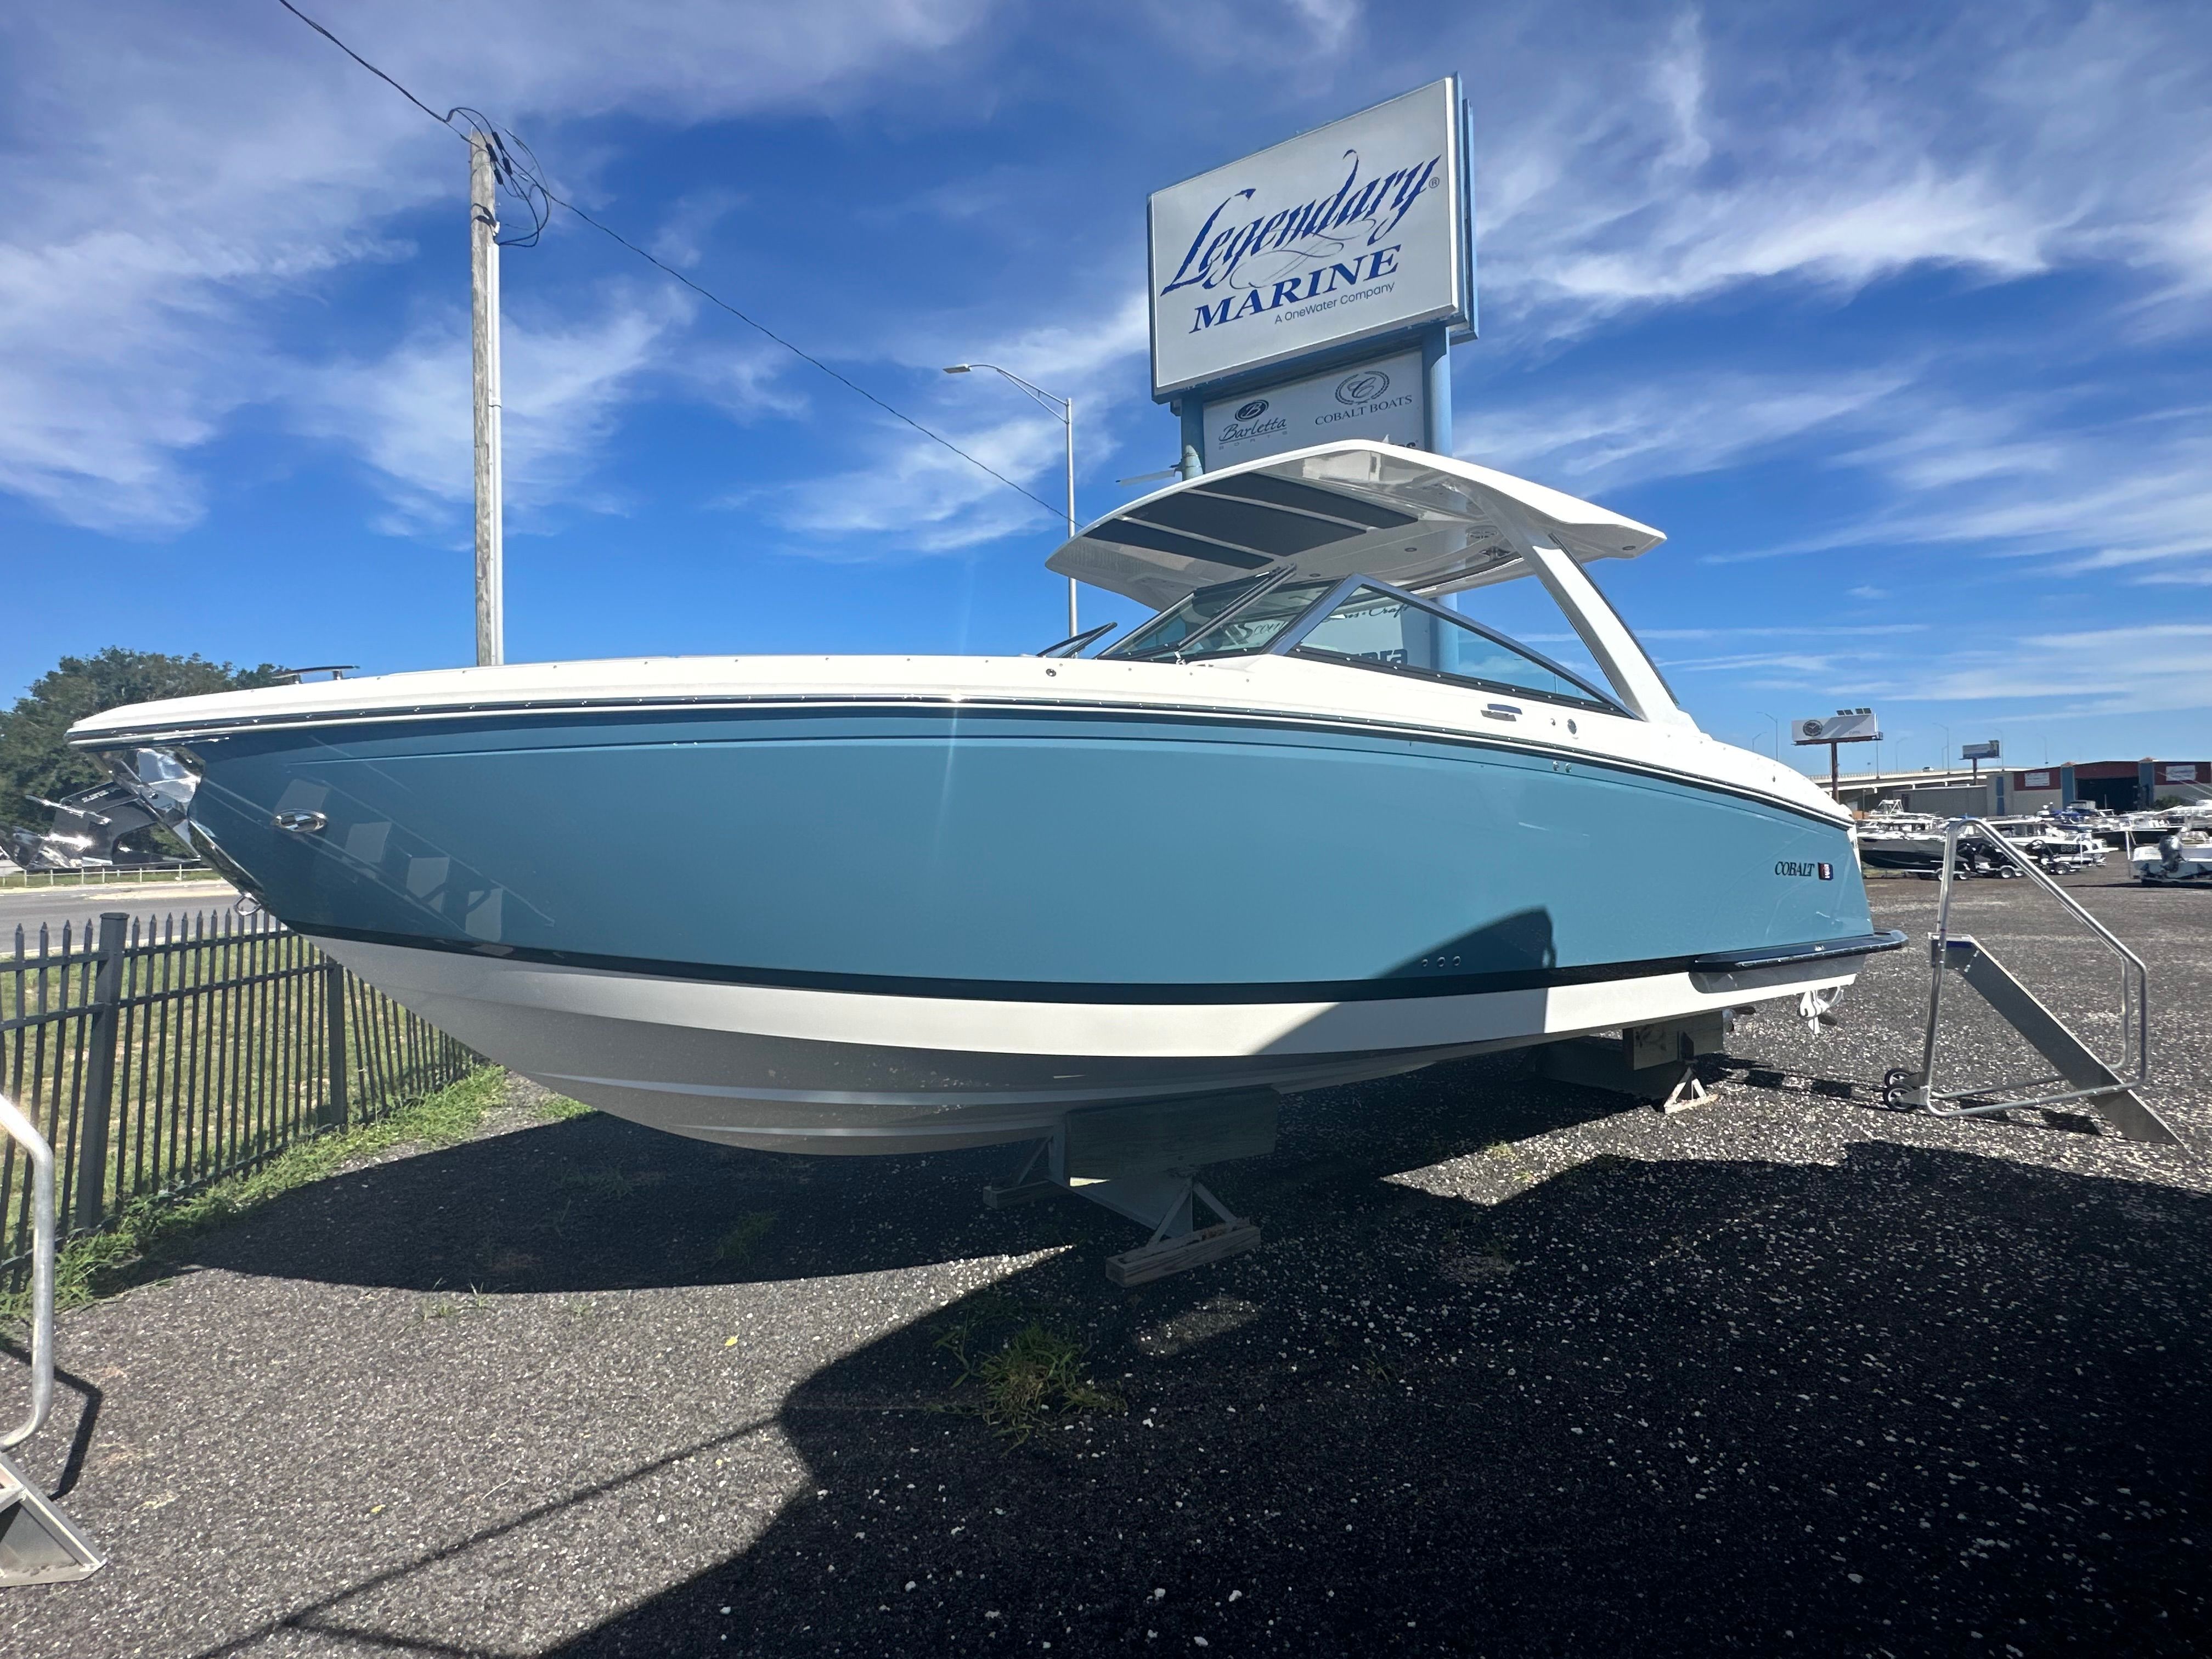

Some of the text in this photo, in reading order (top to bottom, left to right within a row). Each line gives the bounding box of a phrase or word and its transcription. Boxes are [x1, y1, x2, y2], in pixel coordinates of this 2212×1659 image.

[1160, 149, 1441, 297] Legendary
[1189, 244, 1401, 334] MARINE
[1274, 281, 1395, 324] A OneWater Company
[1315, 394, 1413, 425] COBALT BOATS
[1218, 417, 1286, 442] Barletta
[1774, 861, 1815, 877] COBALT
